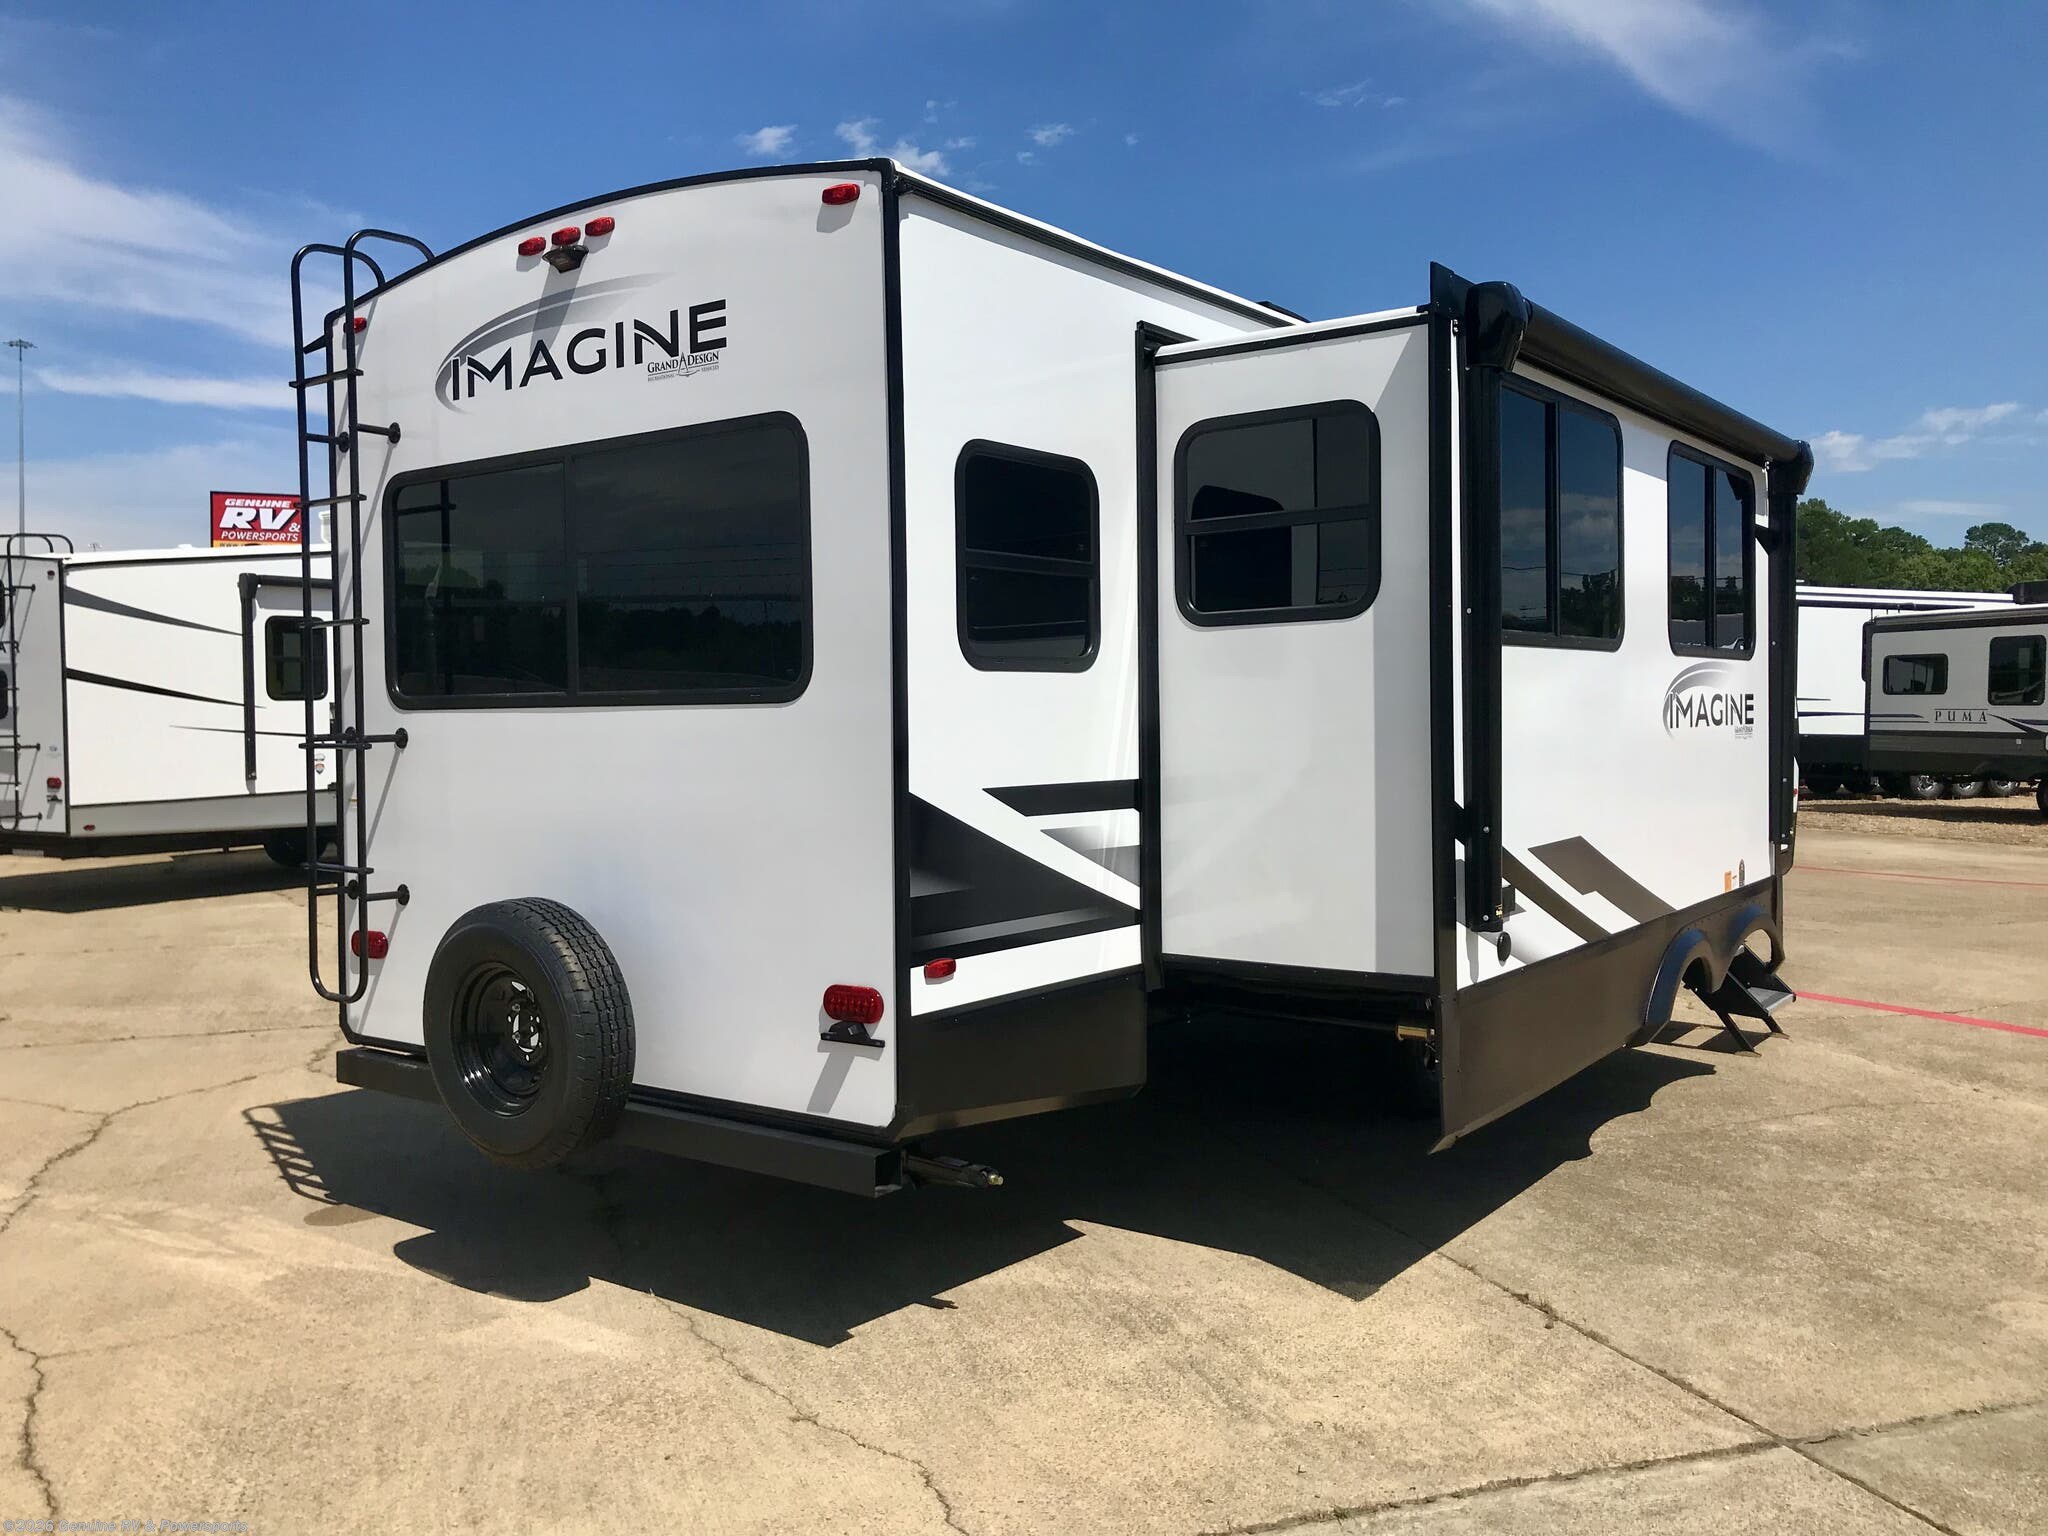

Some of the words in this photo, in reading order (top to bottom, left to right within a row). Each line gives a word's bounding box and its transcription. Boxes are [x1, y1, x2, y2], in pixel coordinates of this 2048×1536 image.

[451, 299, 727, 401] IMAGINE
[647, 359, 679, 373] GRAND
[687, 351, 720, 366] DESIGN
[224, 498, 292, 508] GENUINE
[219, 507, 297, 530] RV
[288, 522, 301, 533] &
[221, 530, 299, 542] POWERSPORTS
[1669, 693, 1755, 729] IMAGINE
[1935, 710, 1987, 722] PUMA
